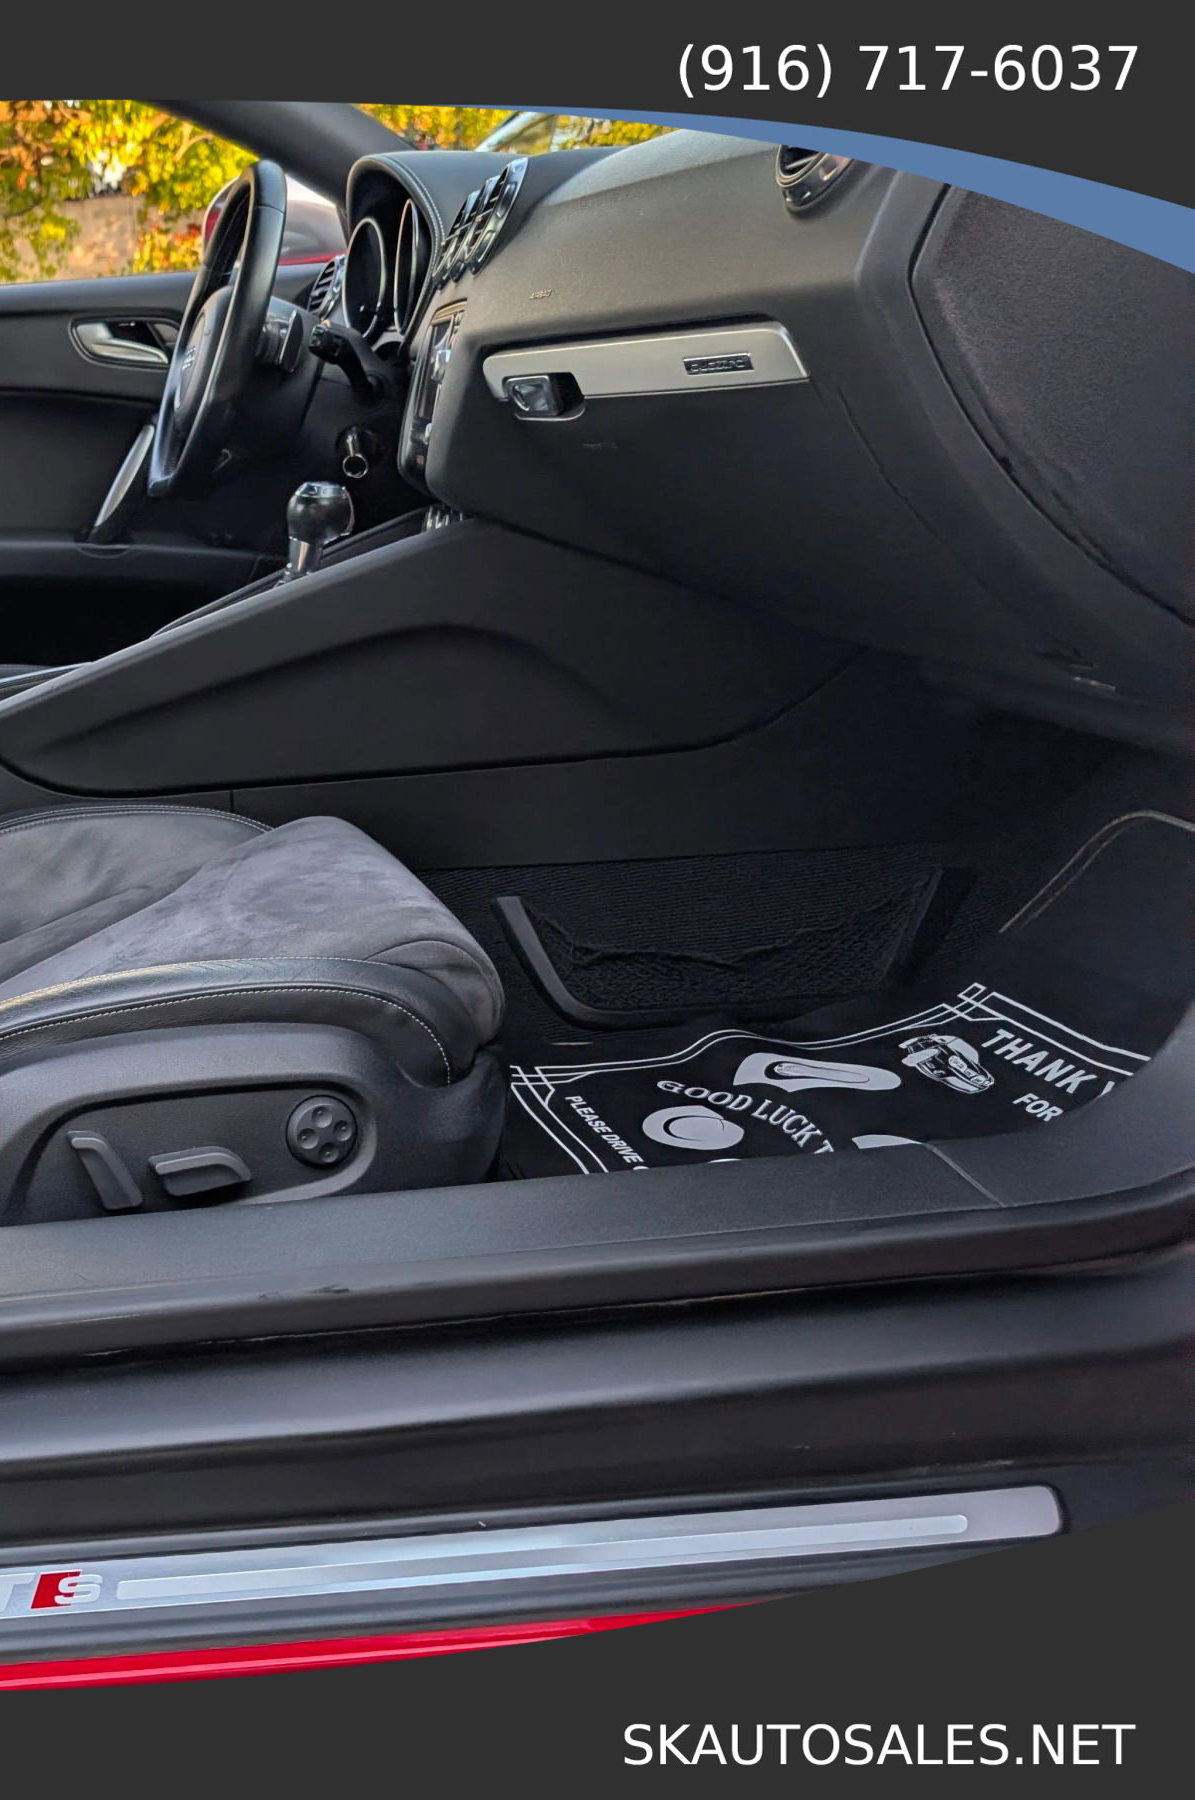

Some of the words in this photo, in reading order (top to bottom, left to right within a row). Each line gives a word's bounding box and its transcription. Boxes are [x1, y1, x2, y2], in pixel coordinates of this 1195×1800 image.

[981, 1028, 1098, 1094] THANK
[564, 1095, 605, 1135] PLEASE
[601, 1129, 644, 1164] DRIVE
[656, 1080, 754, 1111] GOOD
[752, 1099, 823, 1149] LUCK
[1012, 1093, 1064, 1122] FOR
